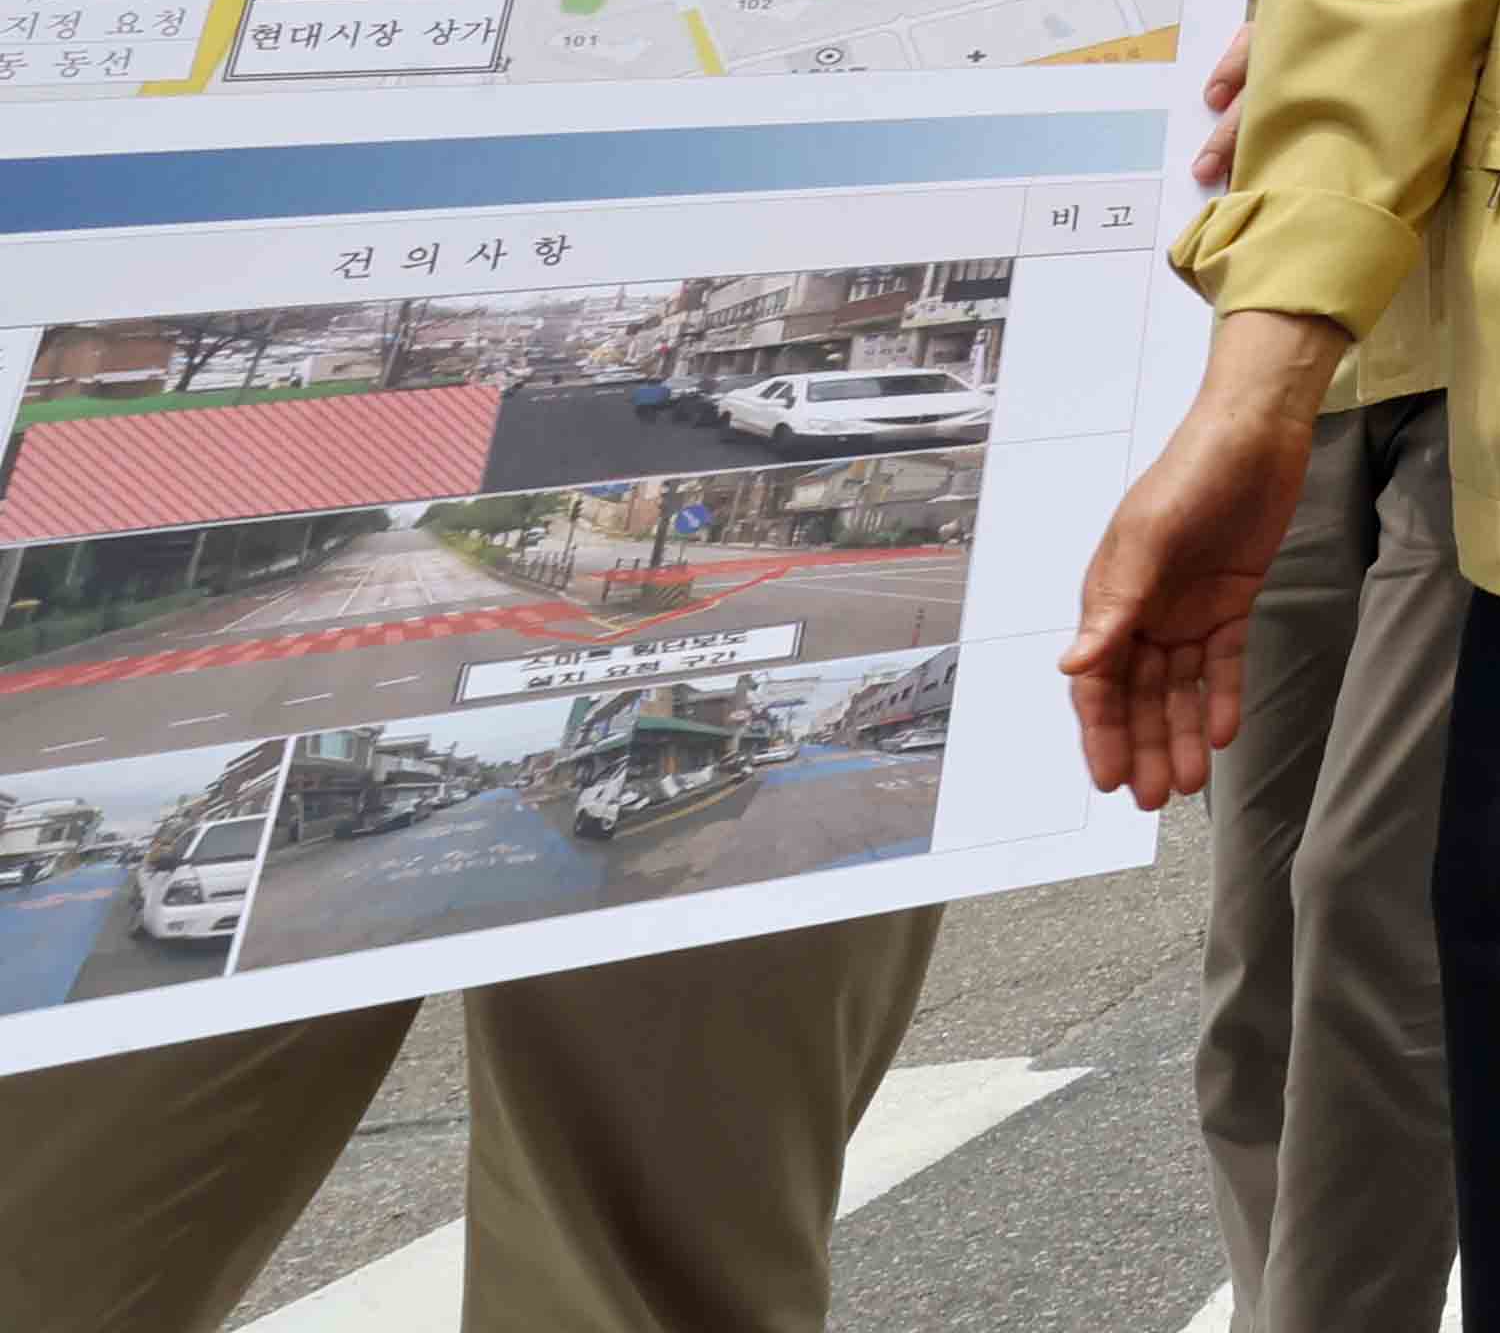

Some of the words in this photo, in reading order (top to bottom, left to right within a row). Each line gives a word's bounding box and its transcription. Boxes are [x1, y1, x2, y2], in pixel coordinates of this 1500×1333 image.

[3, 9, 82, 40] 지정
[104, 7, 186, 37] 요청
[250, 19, 402, 51] 현대시장
[424, 16, 497, 46] 상가
[56, 47, 133, 78] 동선
